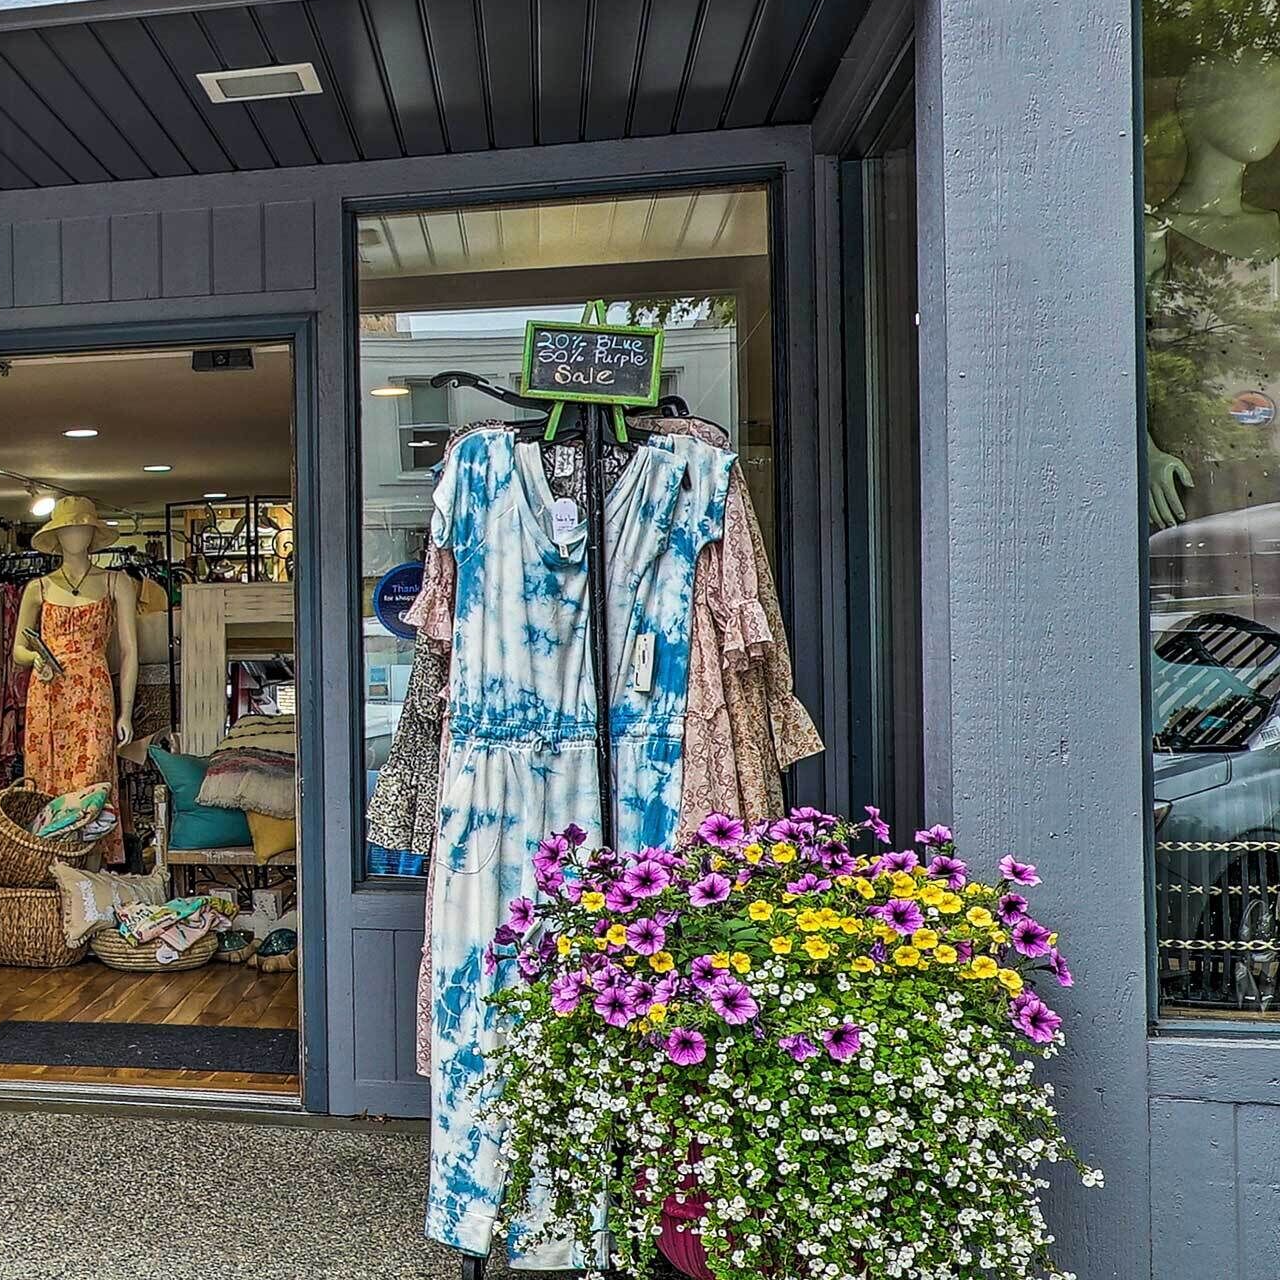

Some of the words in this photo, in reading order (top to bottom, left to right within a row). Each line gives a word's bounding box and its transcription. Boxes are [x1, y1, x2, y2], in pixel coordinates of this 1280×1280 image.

[537, 332, 587, 350] 20%
[539, 347, 584, 363] 50%
[593, 349, 648, 367] Purple
[554, 365, 614, 385] Sale
